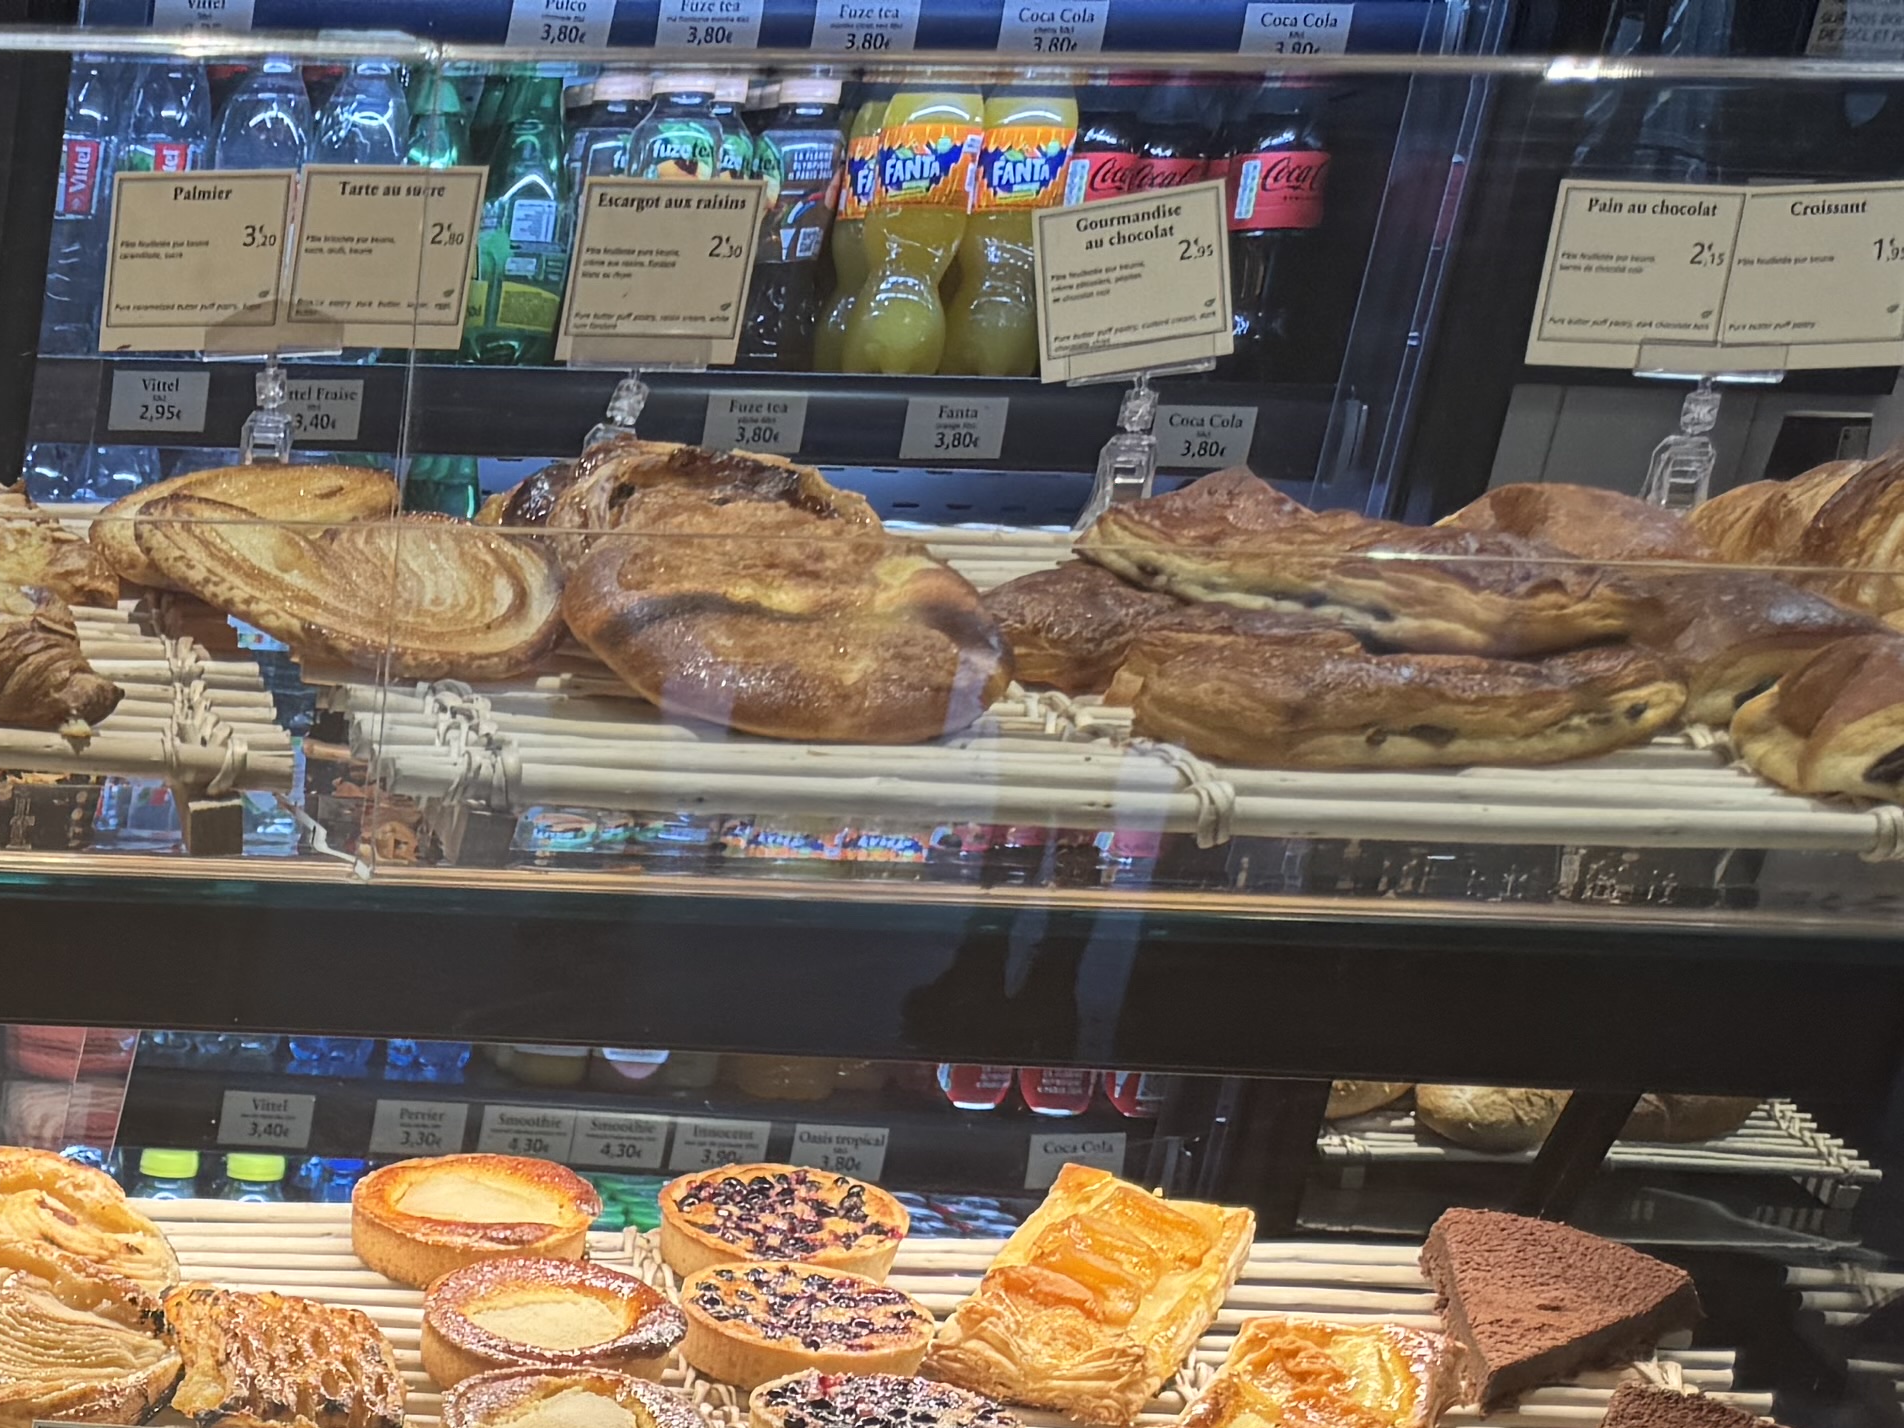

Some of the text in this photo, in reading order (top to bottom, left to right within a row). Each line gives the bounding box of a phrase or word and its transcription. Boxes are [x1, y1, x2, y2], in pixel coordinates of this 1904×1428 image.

[885, 156, 941, 183] FANTA
[993, 158, 1050, 185] FANTA
[172, 184, 233, 201] Palmier
[337, 179, 446, 201] Tarte au sucre
[596, 191, 746, 213] Escargot aux raisins
[1789, 198, 1867, 217] Croissant
[1074, 202, 1182, 233] Gourmandise
[1084, 223, 1174, 251] au chocolat
[140, 376, 180, 393] Vittel
[937, 403, 979, 420] Fanta
[1167, 411, 1243, 429] Coca Cola
